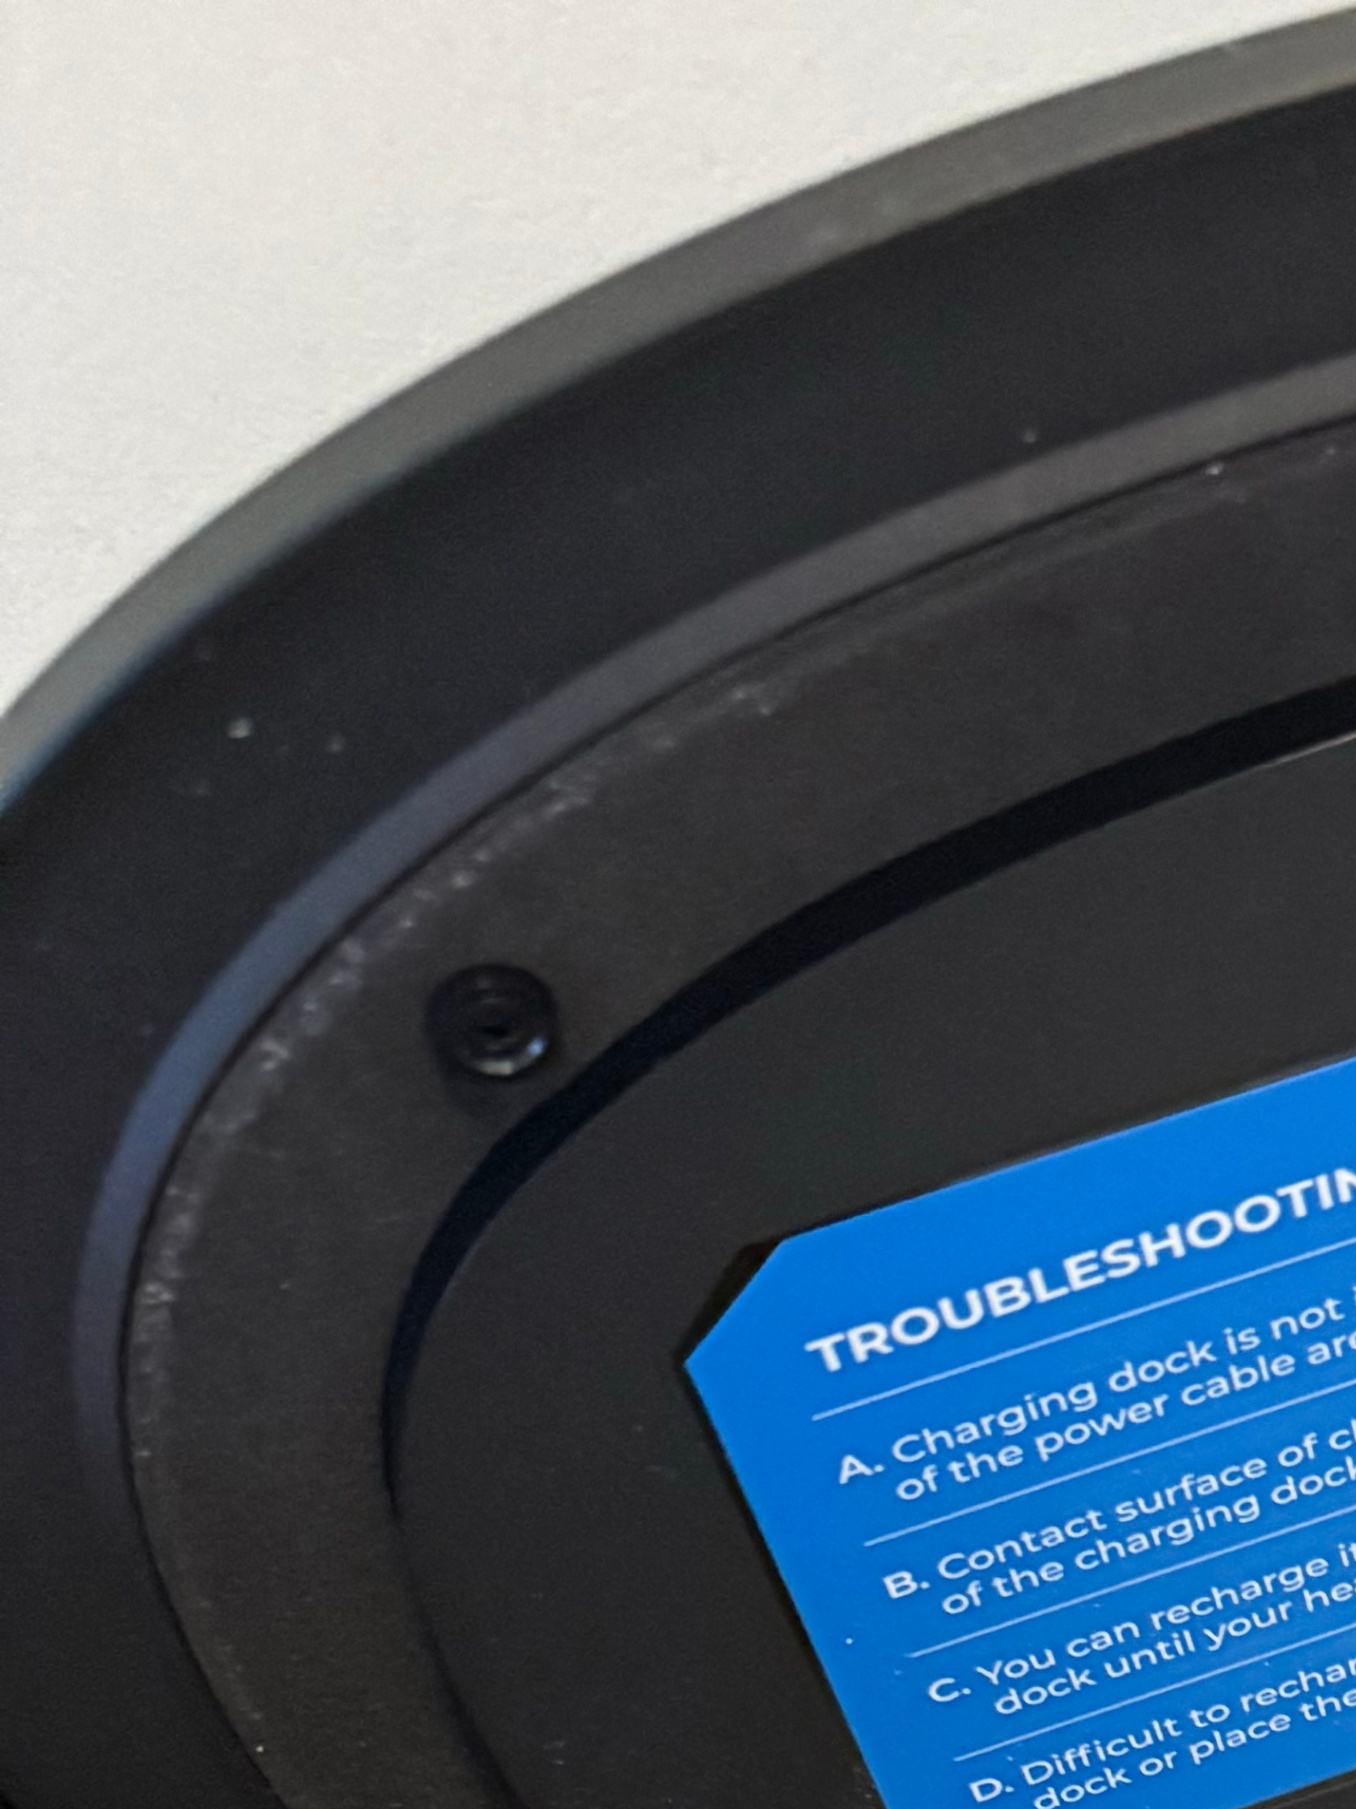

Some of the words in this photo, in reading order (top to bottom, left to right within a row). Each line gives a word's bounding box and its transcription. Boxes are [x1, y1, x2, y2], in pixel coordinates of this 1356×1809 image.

[839, 1455, 884, 1485] A.
[892, 1382, 1098, 1463] Charging
[1108, 1341, 1217, 1392] dock
[1224, 1327, 1261, 1355] is
[1270, 1298, 1345, 1340] not
[896, 1465, 937, 1500] of
[948, 1445, 1023, 1483] the
[1035, 1394, 1168, 1462] power
[1181, 1354, 1295, 1406] cable
[883, 1571, 930, 1599] B.
[937, 1510, 1107, 1579] Contact
[1115, 1458, 1267, 1523] surface
[1277, 1432, 1318, 1468] of
[942, 1580, 982, 1614] of
[992, 1561, 1064, 1597] the
[1075, 1495, 1260, 1570] charging
[928, 1677, 971, 1702] C.
[976, 1649, 1056, 1685] You
[1066, 1622, 1140, 1658] can
[1150, 1558, 1329, 1631] recharge
[995, 1668, 1096, 1715] dock
[1104, 1629, 1196, 1678] until
[1203, 1601, 1292, 1652] your
[969, 1777, 1014, 1803] D.
[1021, 1718, 1182, 1785] Difficult
[1189, 1704, 1231, 1728] to
[1139, 1751, 1177, 1776] or
[1189, 1714, 1291, 1765] place
